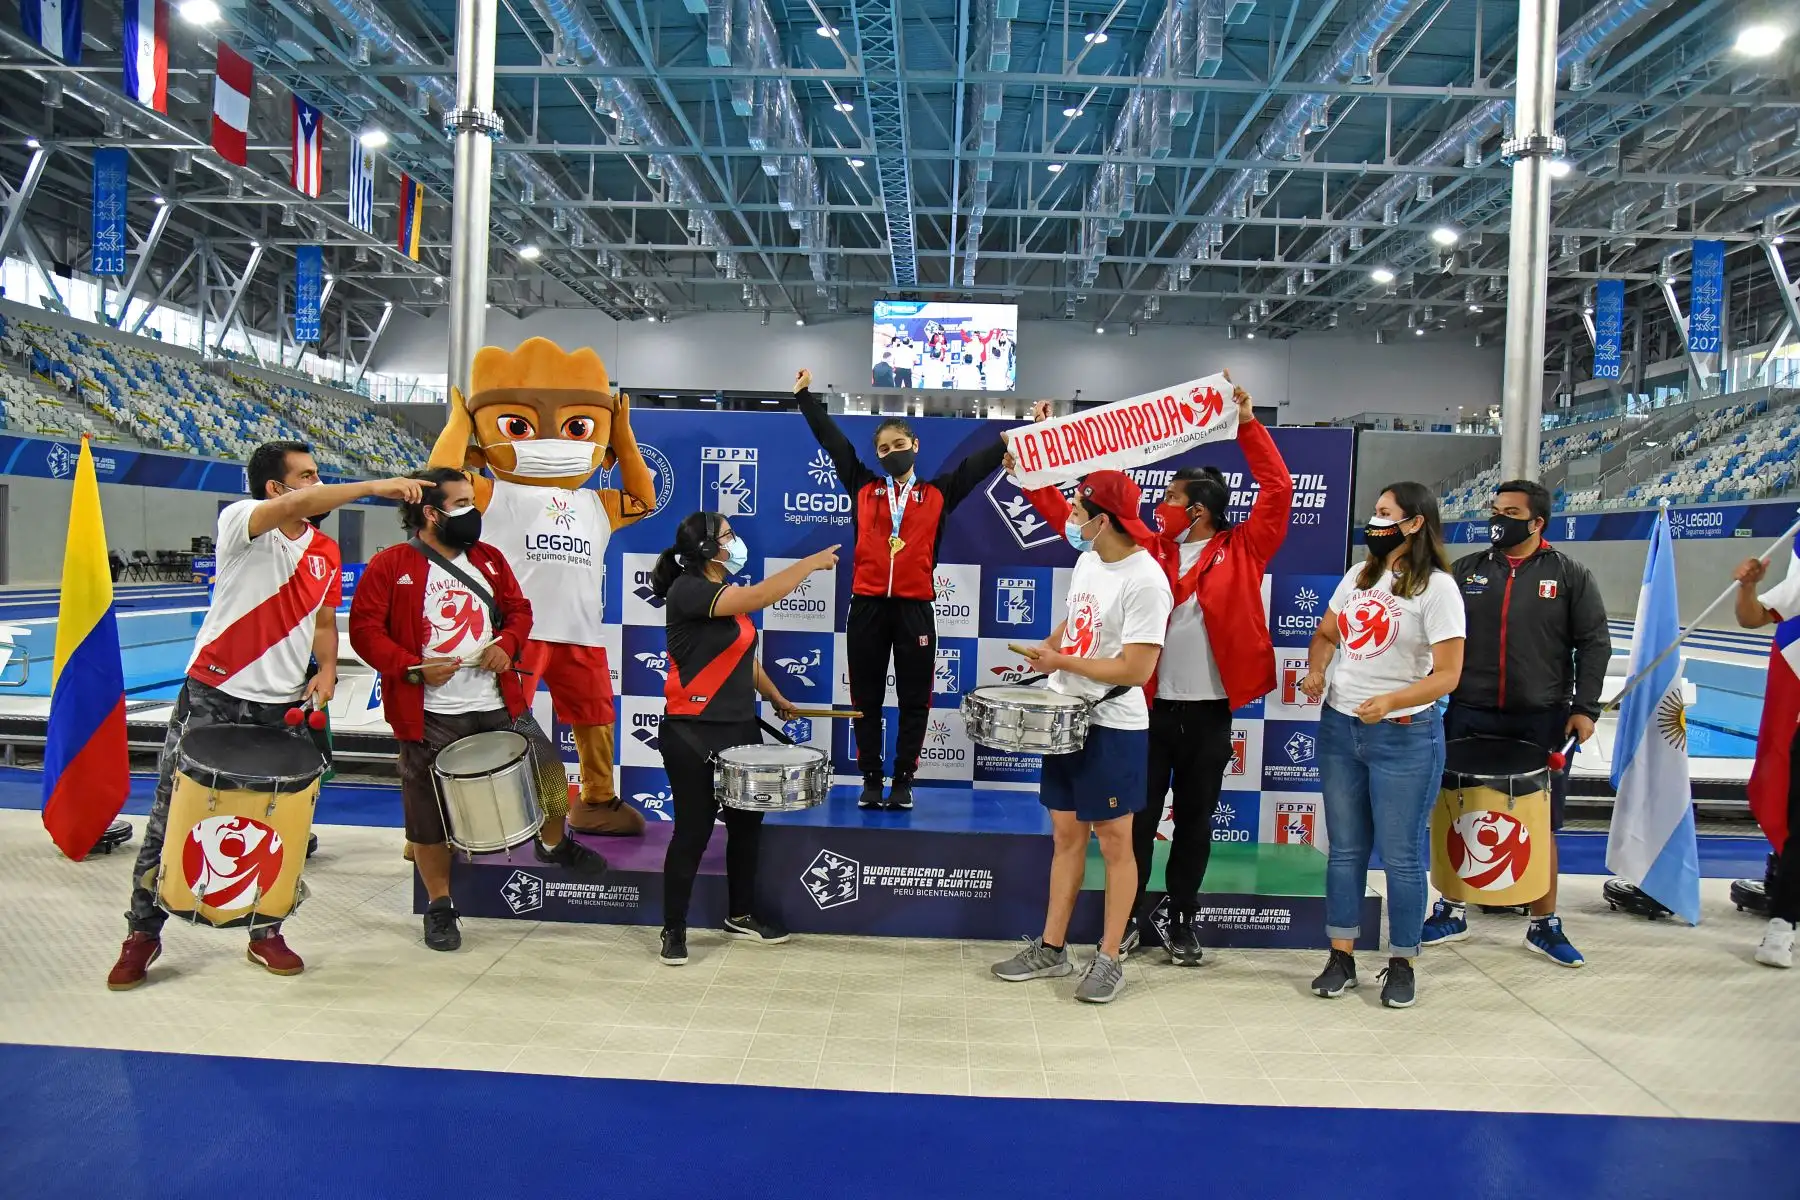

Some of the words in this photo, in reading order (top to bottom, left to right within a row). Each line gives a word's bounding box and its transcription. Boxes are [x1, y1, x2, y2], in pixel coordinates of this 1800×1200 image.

[94, 257, 125, 273] 213
[296, 328, 320, 341] 212
[1690, 337, 1718, 350] 207
[1595, 364, 1619, 377] 208
[1015, 433, 1043, 473] LA
[1040, 395, 1184, 469] BLANQUIRROJA
[704, 448, 755, 460] FDPN
[784, 492, 852, 513] LEGAD
[784, 512, 829, 525] Seguimos
[1292, 512, 1321, 525] 2021
[525, 551, 567, 562] Seguimos
[999, 579, 1034, 587] FDPN
[646, 658, 666, 669] IPD
[787, 664, 807, 674] IPD
[1285, 660, 1310, 668] FDP
[1002, 672, 1022, 682] IPD
[375, 678, 382, 701] 6
[644, 799, 664, 810] IPD
[1278, 804, 1314, 812] FDPN
[862, 866, 946, 878] SUDAMERICANO
[949, 868, 994, 880] JUVENIL
[862, 876, 877, 885] DE
[880, 877, 933, 887] DEPORTES
[545, 882, 605, 892] SUDAMERICANO
[607, 885, 640, 894] JUVENIL
[893, 887, 915, 896] PERÚ
[916, 888, 973, 898] BICENTENARIO
[974, 890, 992, 899] 2021
[558, 890, 597, 899] DEPORTES
[583, 900, 625, 908] BICENTENARIO
[1258, 908, 1292, 917] JUVENIL
[1194, 914, 1206, 922] DE
[1207, 915, 1247, 923] DEPORTES
